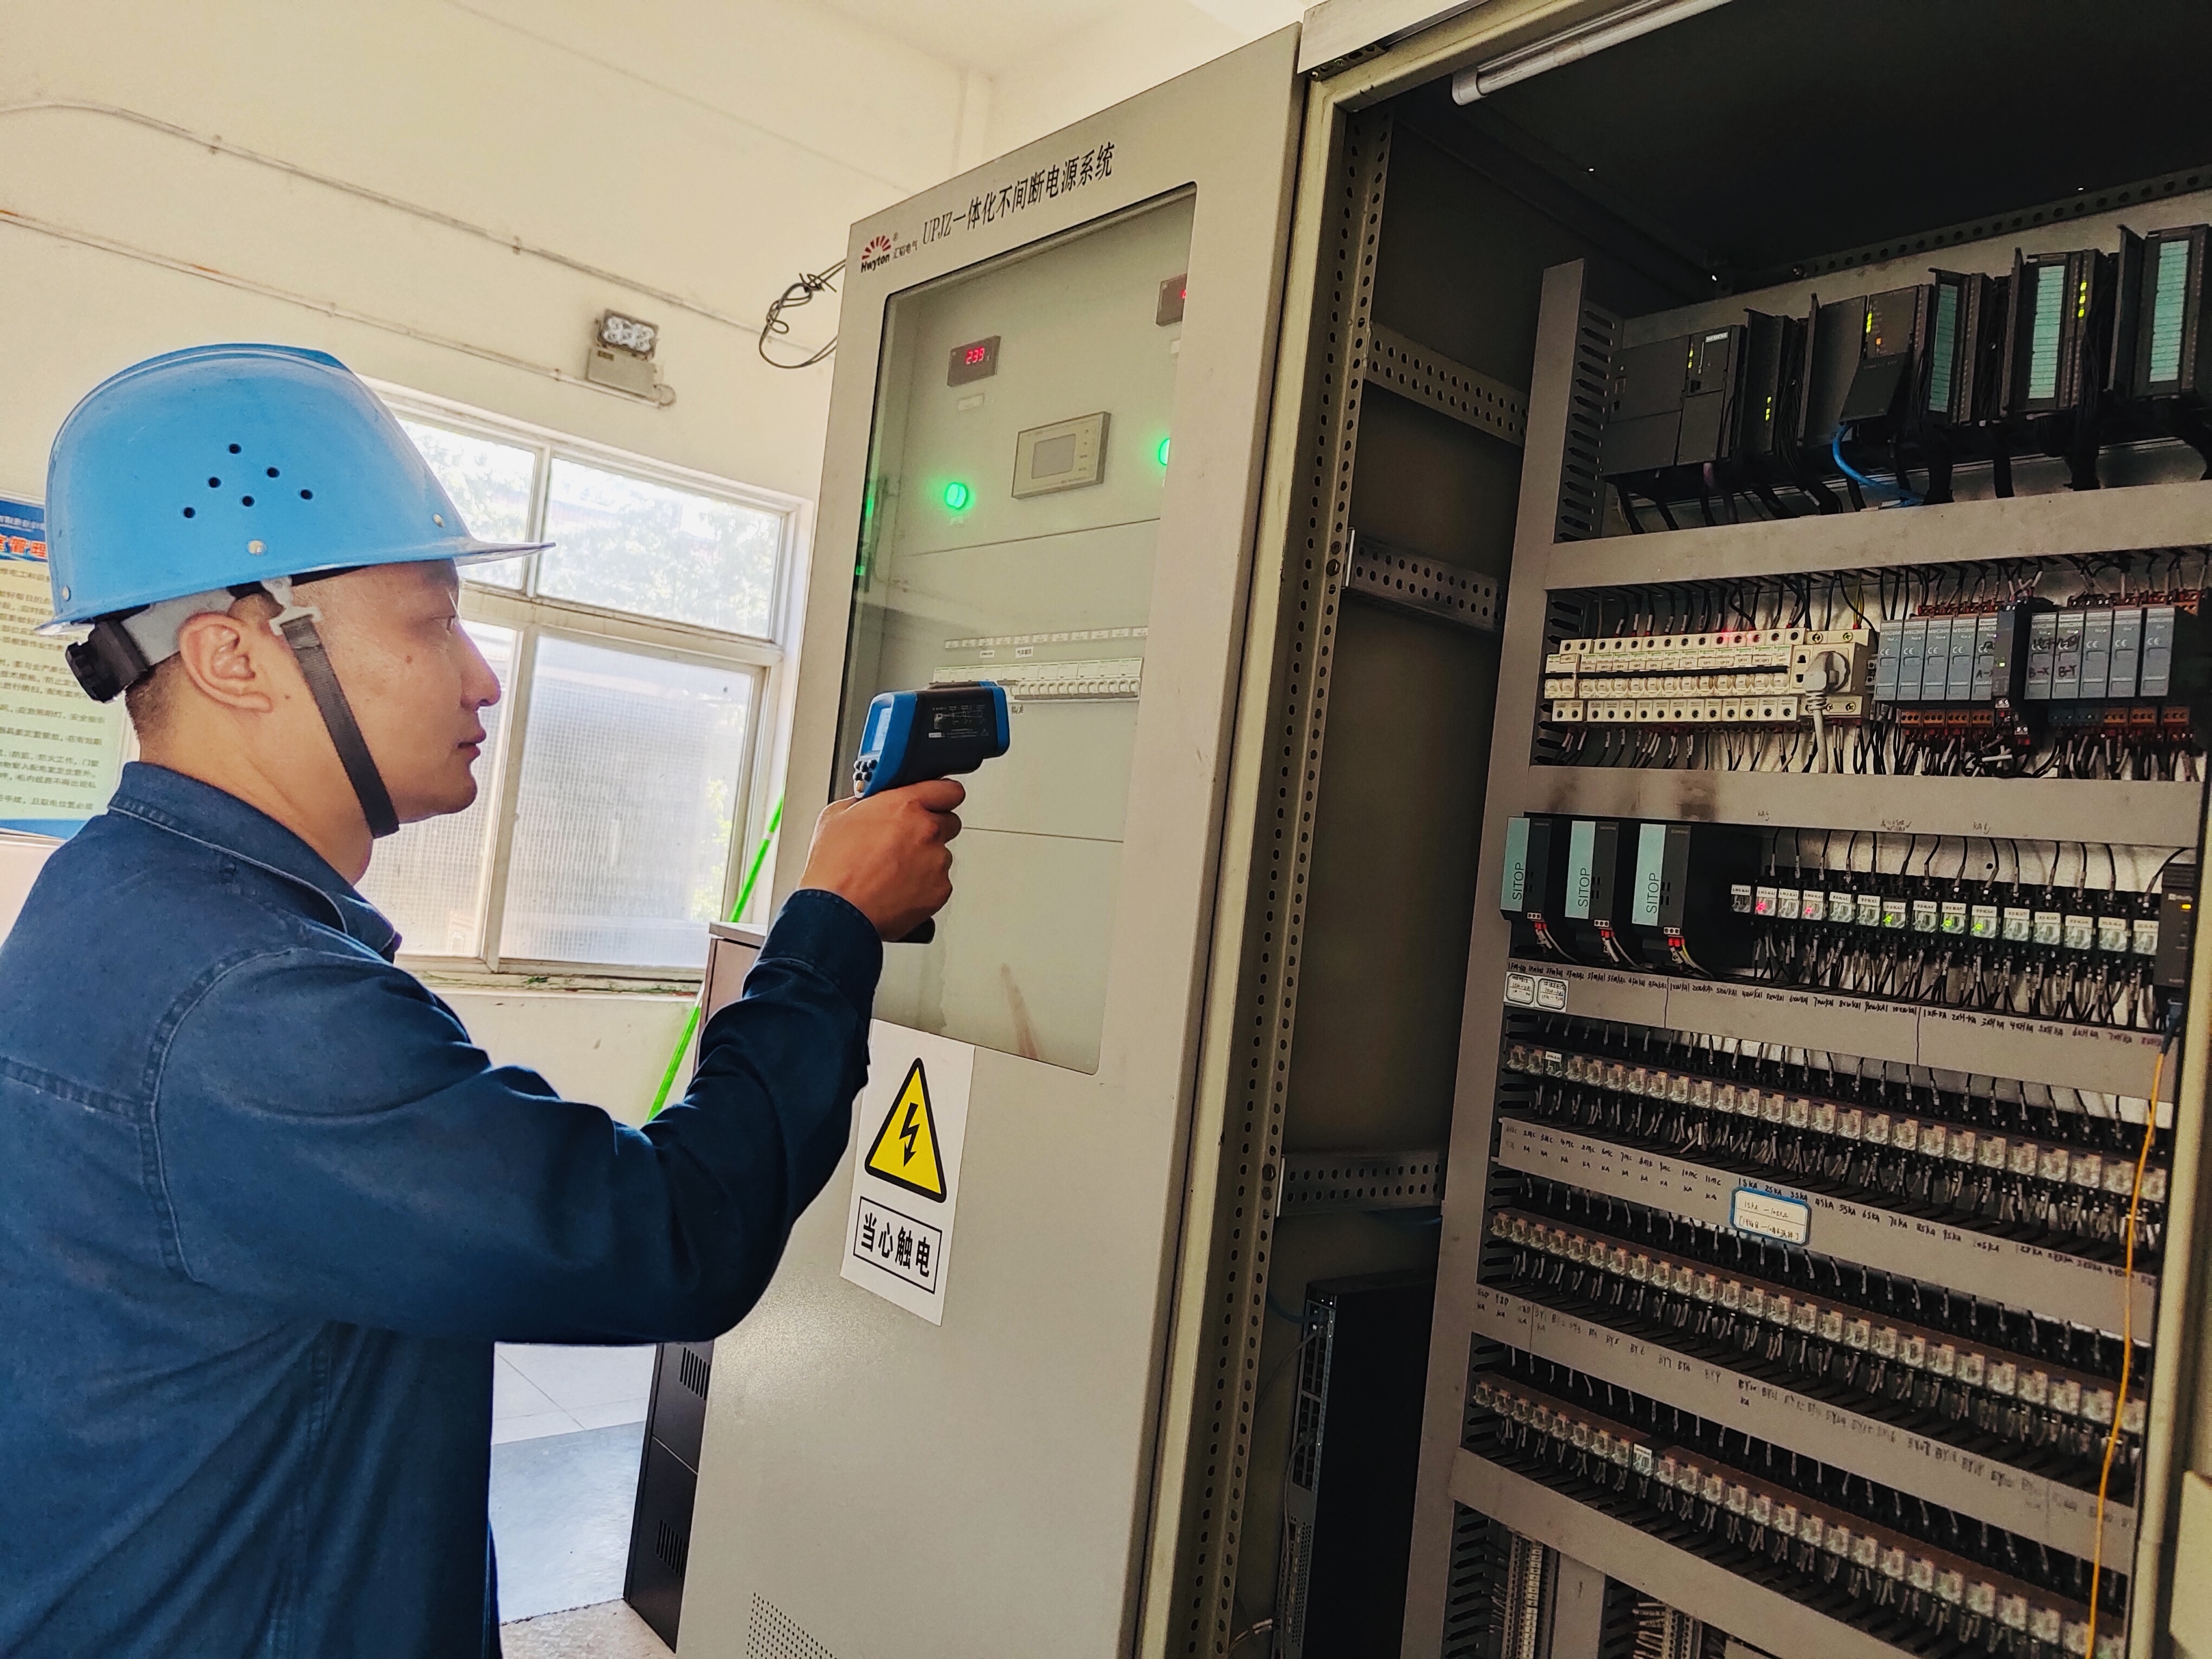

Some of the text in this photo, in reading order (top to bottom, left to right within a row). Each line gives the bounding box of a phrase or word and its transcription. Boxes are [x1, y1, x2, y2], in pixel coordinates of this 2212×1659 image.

[965, 348, 985, 365] 239
[1512, 862, 1526, 901] SITOP
[1578, 867, 1591, 907] SITOP
[1646, 872, 1660, 914] SITOP
[860, 1212, 931, 1278] 当心触电
